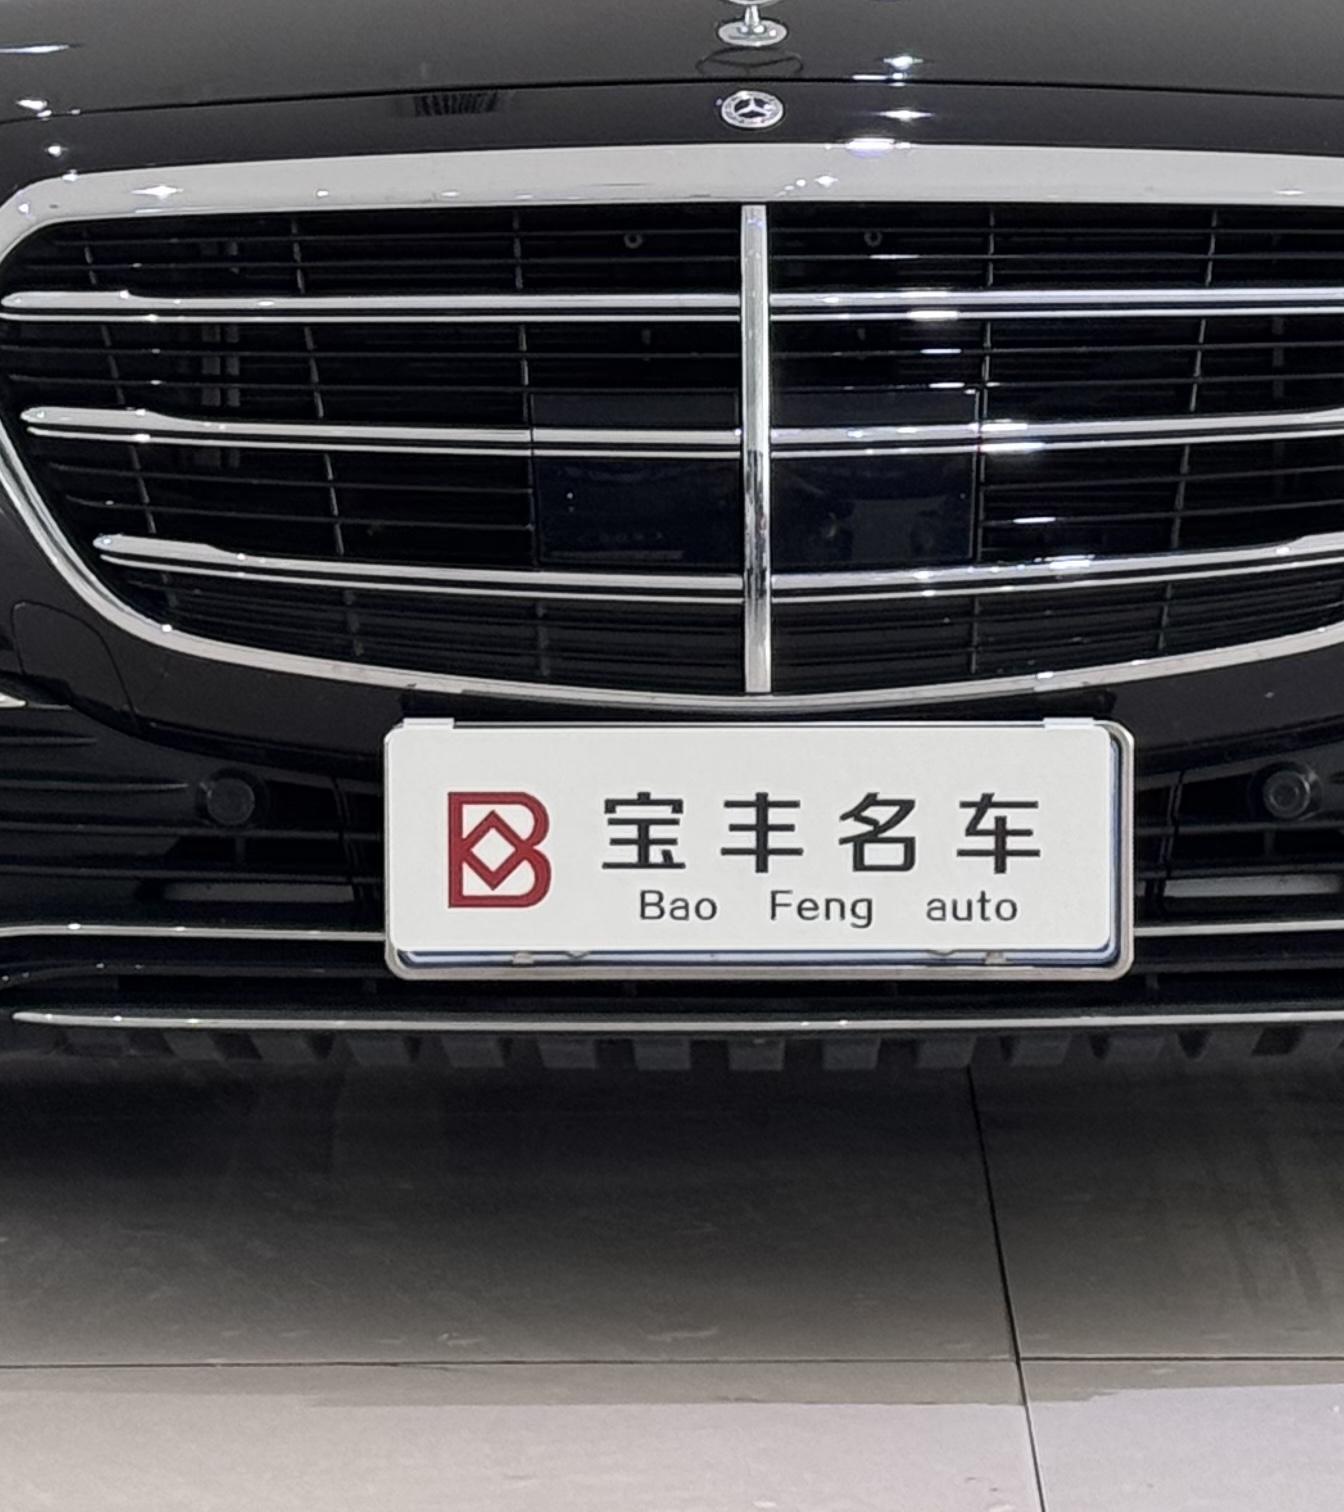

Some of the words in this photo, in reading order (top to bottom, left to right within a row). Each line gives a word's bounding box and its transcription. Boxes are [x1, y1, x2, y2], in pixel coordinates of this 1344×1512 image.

[601, 791, 1041, 875] 宝丰名车
[639, 889, 718, 921] Bao
[770, 889, 873, 929] Feng
[926, 890, 1018, 922] auto
